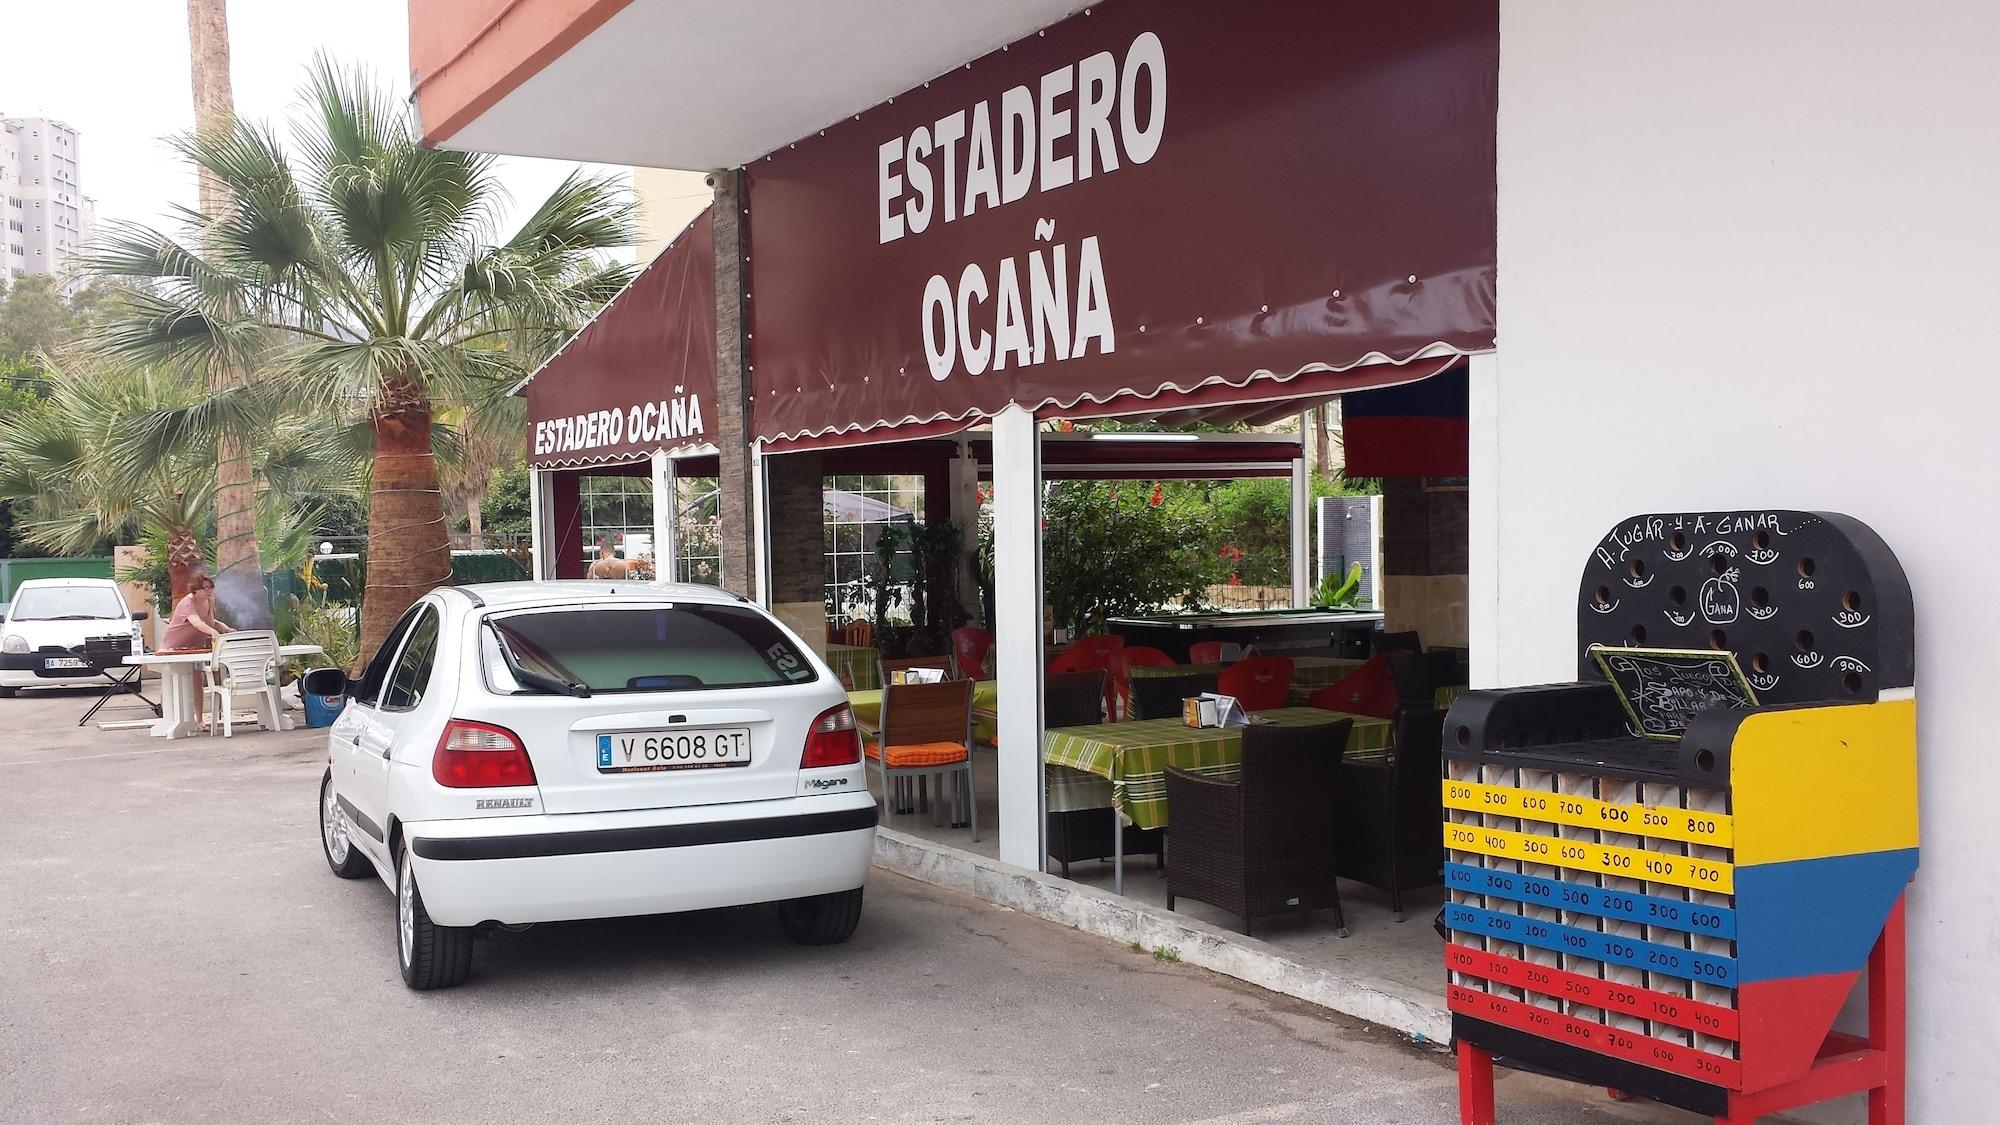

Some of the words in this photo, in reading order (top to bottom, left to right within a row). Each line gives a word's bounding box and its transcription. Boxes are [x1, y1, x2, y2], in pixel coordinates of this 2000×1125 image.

[879, 32, 1167, 244] ESTADERO
[922, 218, 1115, 381] OCAÑA
[535, 407, 623, 455] ESTADERO
[628, 385, 704, 444] OCAÑA
[1706, 545, 1735, 558] 3.000
[1751, 550, 1773, 560] 700
[1798, 580, 1814, 589] 600
[1706, 588, 1733, 615] GANA
[1752, 606, 1772, 616] 700
[1839, 612, 1861, 623] 900
[1797, 652, 1818, 664] 600
[1840, 661, 1862, 672] 900
[1753, 675, 1773, 685] 700
[621, 739, 634, 762] V
[645, 736, 706, 760] 6608
[715, 734, 742, 757] GT
[476, 798, 533, 809] RENAULT
[1450, 787, 1471, 799] 800
[1484, 792, 1507, 805] 500
[1522, 797, 1546, 810] 600
[1559, 801, 1583, 815] 700
[1600, 807, 1629, 822] 600
[1644, 813, 1668, 825] 500
[1687, 819, 1715, 834] 800
[1451, 829, 1475, 843] 700
[1485, 836, 1505, 850] 400
[1523, 840, 1548, 854] 300
[1561, 844, 1585, 860] 600
[1602, 852, 1631, 868] 300
[1646, 859, 1673, 875] 400
[1689, 866, 1719, 882] 700
[1450, 870, 1471, 882] 600
[1487, 876, 1512, 891] 300
[1524, 881, 1550, 897] 200
[1563, 889, 1589, 905] 500
[1603, 895, 1633, 912] 200
[1649, 904, 1678, 921] 300
[1691, 912, 1720, 929] 600
[1453, 911, 1474, 924] 500
[1488, 917, 1511, 930] 200
[1526, 925, 1548, 938] 100
[1563, 933, 1587, 948] 400
[1605, 943, 1634, 958] 100
[1649, 950, 1678, 968] 200
[1693, 960, 1727, 979] 500
[1453, 953, 1473, 966] 400
[1489, 962, 1508, 975] 100
[1527, 970, 1549, 984] 200
[1565, 980, 1590, 995] 500
[1608, 990, 1635, 1005] 200
[1653, 1001, 1678, 1018] 100
[1695, 1012, 1719, 1028] 400
[1453, 989, 1474, 1003] 900
[1490, 1002, 1508, 1014] 600
[1529, 1011, 1550, 1025] 700
[1565, 1024, 1590, 1038] 800
[1608, 1033, 1633, 1049] 700
[1653, 1048, 1674, 1062] 600
[1696, 1058, 1721, 1074] 900
